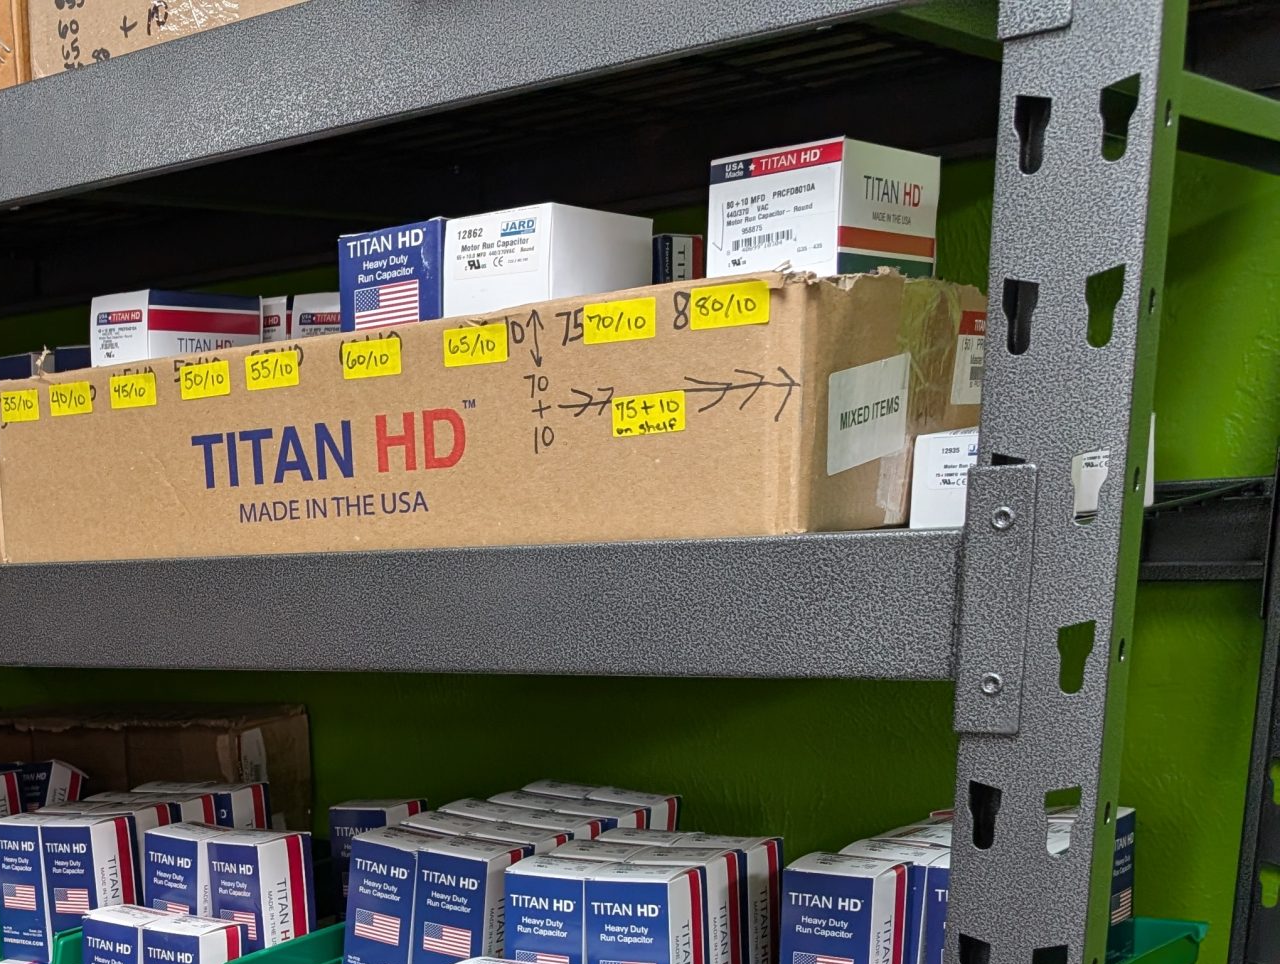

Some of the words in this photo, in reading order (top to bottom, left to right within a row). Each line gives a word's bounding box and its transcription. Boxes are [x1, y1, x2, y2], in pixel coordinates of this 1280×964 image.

[58, 19, 79, 40] 60
[61, 41, 80, 62] 65
[725, 163, 744, 172] USA
[760, 153, 797, 171] TITAN
[801, 149, 820, 163] HD
[725, 170, 744, 179] Made
[751, 194, 765, 204] MFD
[864, 175, 899, 205] TITAN
[903, 184, 921, 207] HD
[757, 204, 769, 212] VAC
[794, 202, 813, 212] Round
[872, 211, 886, 222] MADE
[457, 227, 484, 240] 12862
[501, 218, 536, 233] JARD
[346, 234, 394, 259] TITAN
[397, 228, 424, 250] HD
[461, 242, 481, 253] Motor
[482, 240, 495, 250] Run
[496, 236, 530, 248] Capacitor
[362, 256, 387, 272] Heavy
[387, 253, 409, 269] Duty
[357, 270, 374, 284] Run
[375, 265, 415, 282] Capacitor
[695, 293, 757, 316] 80/10
[110, 312, 130, 324] TITAN
[130, 310, 141, 321] HD
[587, 306, 647, 333] 70/10
[177, 337, 214, 353] TITAN
[215, 339, 233, 350] HD
[448, 334, 496, 355] 65/10
[344, 350, 390, 371] 60/10
[184, 370, 225, 389] 50/10
[250, 360, 293, 381] 55/10
[113, 382, 147, 400] 45/10
[523, 374, 550, 400] 70
[2, 394, 34, 412] 35/10
[50, 391, 86, 409] 40/10
[615, 397, 680, 420] 75+10
[838, 401, 873, 432] MIXED
[873, 394, 900, 425] ITEMS
[637, 416, 678, 435] shelf
[191, 419, 355, 489] TITAN
[375, 407, 467, 473] HD
[533, 426, 555, 454] 10
[239, 499, 301, 524] MADE
[305, 498, 327, 520] IN
[331, 495, 376, 518] THE
[381, 490, 429, 514] USA
[21, 841, 34, 851] HD
[212, 861, 237, 873] TITAN
[239, 864, 253, 875] HD
[510, 894, 550, 910] TITAN
[552, 896, 574, 913] HD
[789, 892, 833, 909] TITAN
[838, 896, 862, 912] HD
[517, 924, 533, 934] Run
[534, 926, 568, 939] Capacitor
[521, 916, 541, 927] Heavy
[542, 918, 564, 930] Duty
[800, 915, 823, 927] Heavy
[824, 918, 848, 929] Duty
[795, 924, 812, 935] Run
[813, 927, 853, 940] Capacitor
